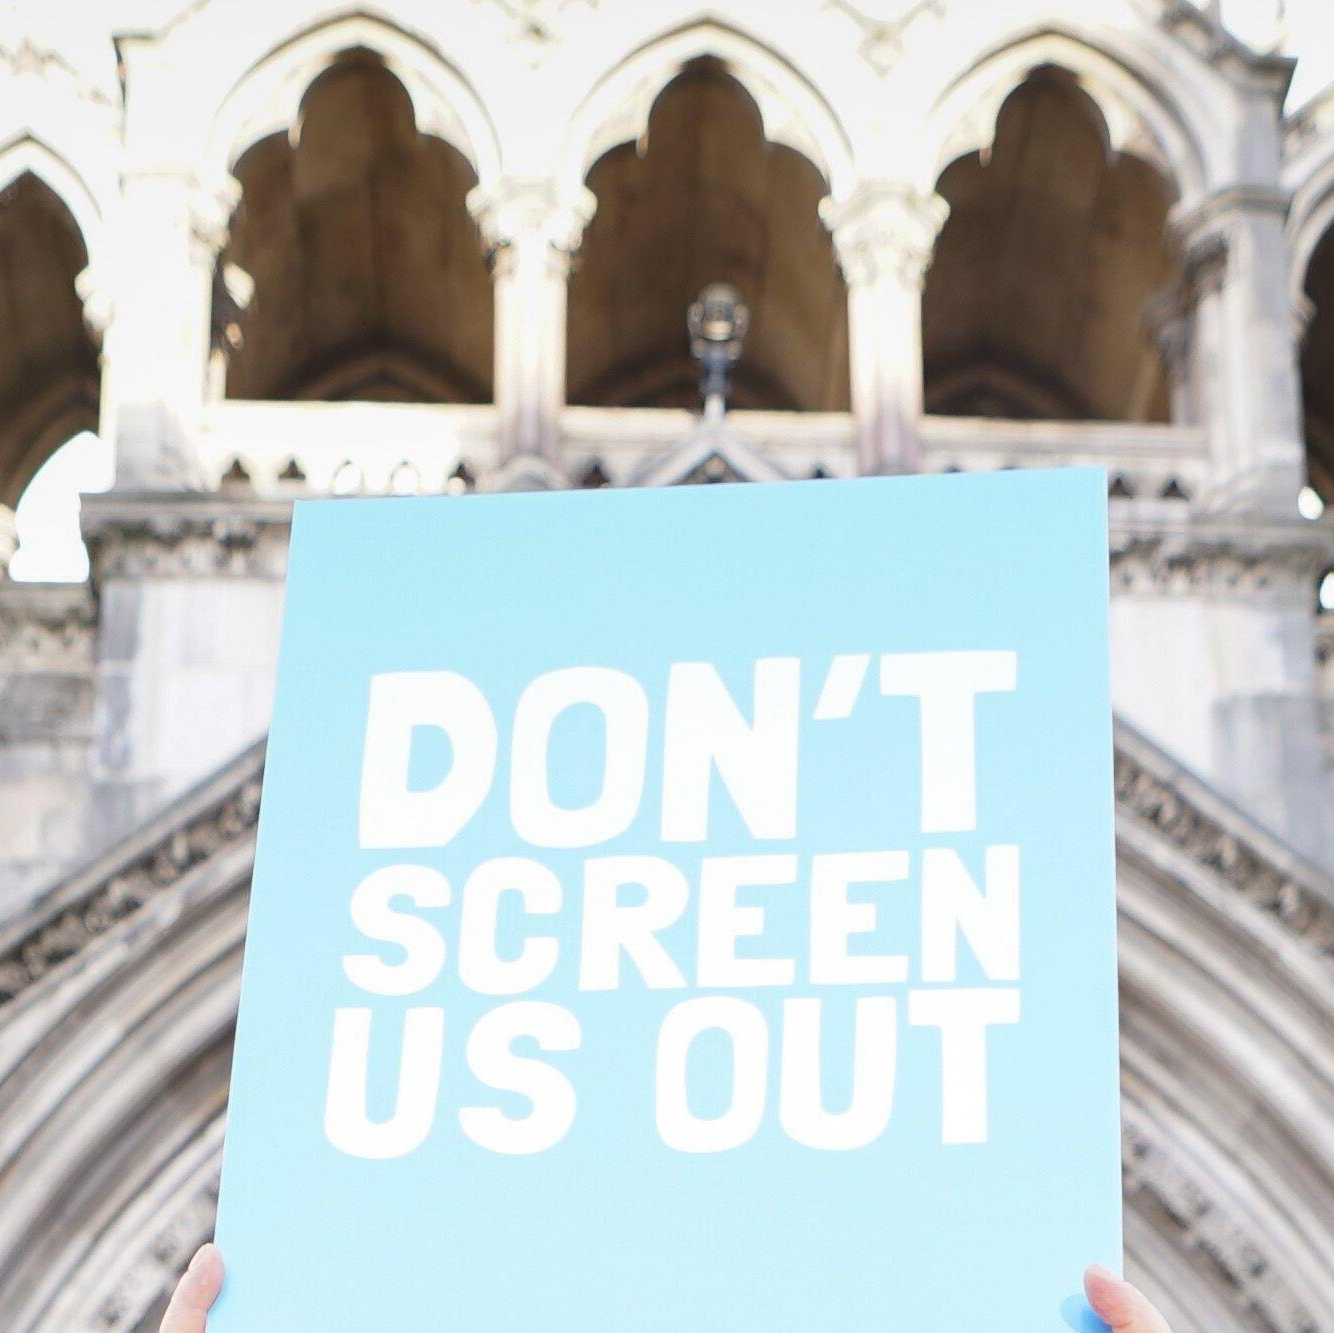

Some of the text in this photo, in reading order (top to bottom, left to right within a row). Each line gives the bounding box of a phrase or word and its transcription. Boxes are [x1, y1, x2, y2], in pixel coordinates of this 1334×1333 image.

[358, 650, 1017, 849] DON'T
[341, 844, 1021, 996] SCREEN
[323, 988, 1021, 1160] US OUT
